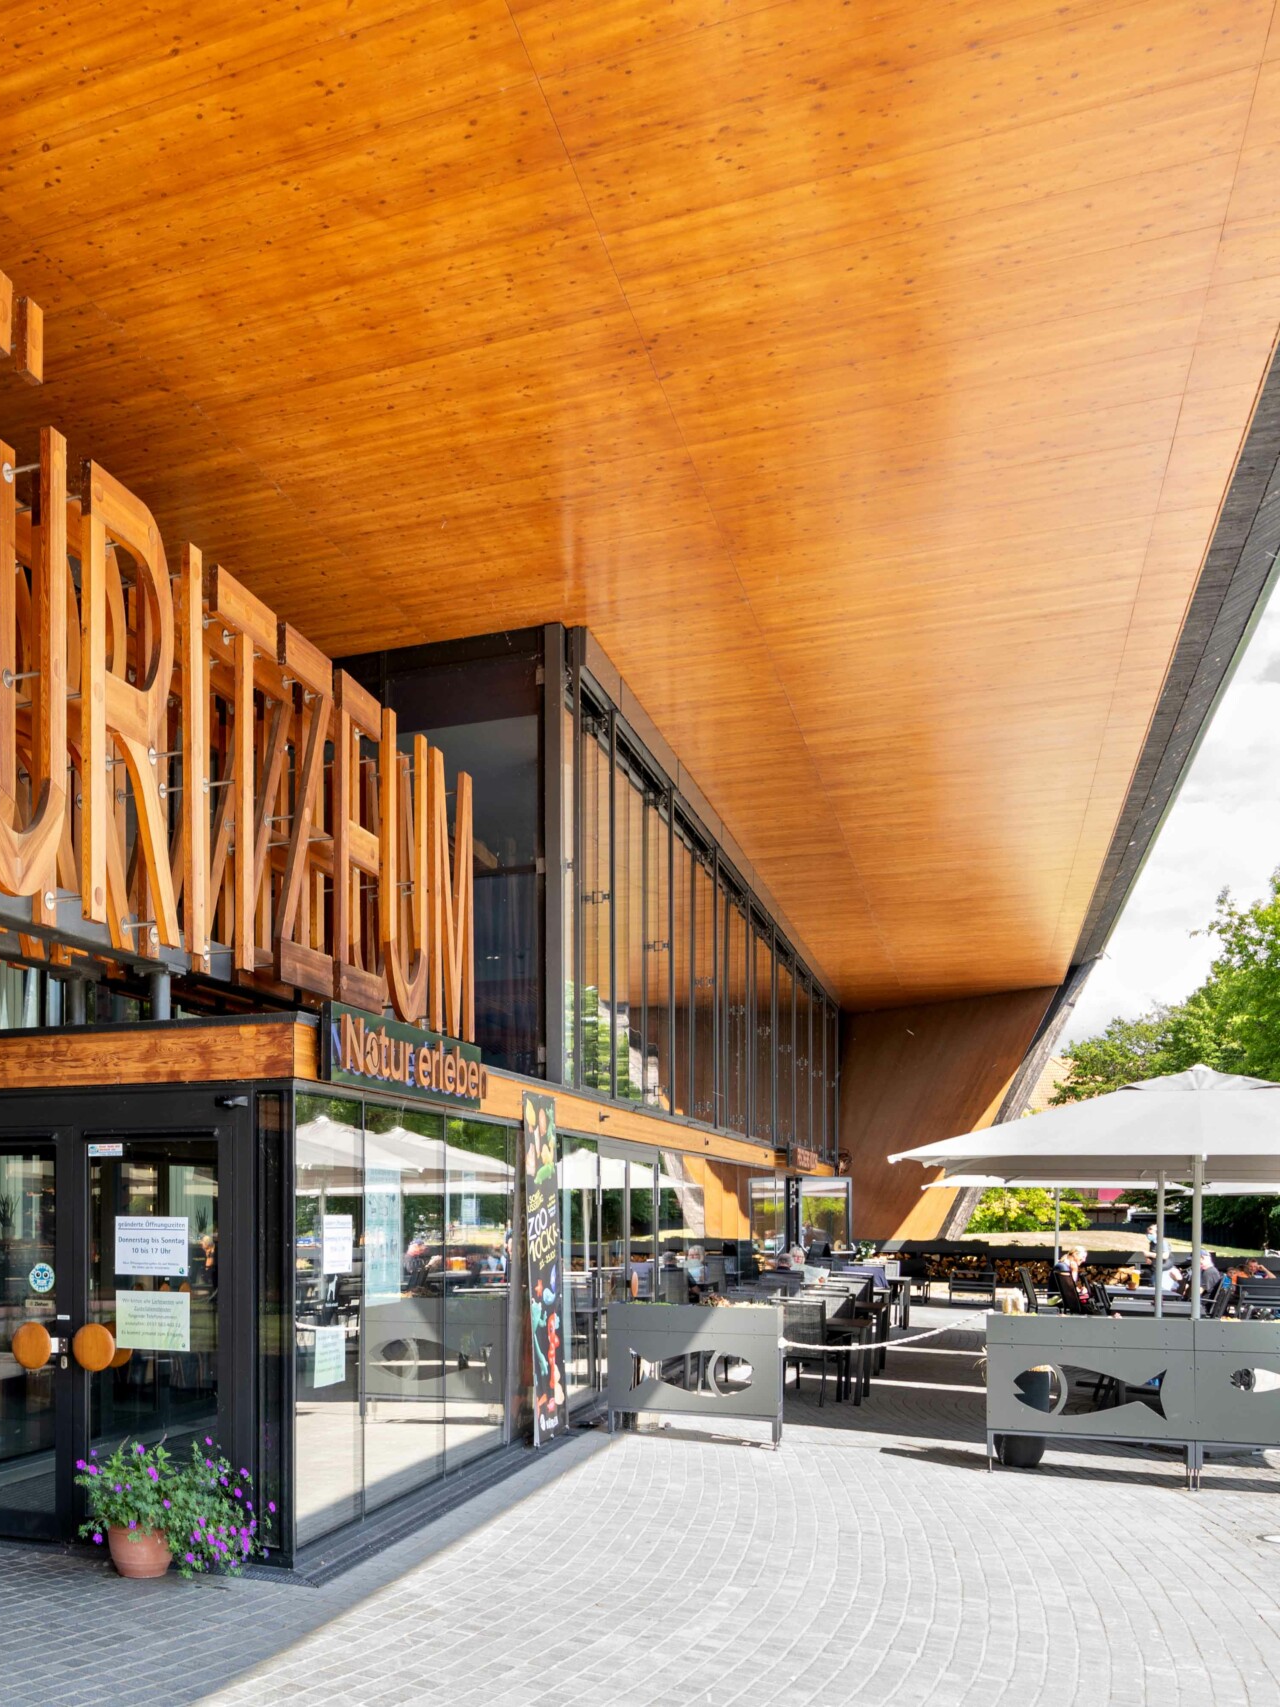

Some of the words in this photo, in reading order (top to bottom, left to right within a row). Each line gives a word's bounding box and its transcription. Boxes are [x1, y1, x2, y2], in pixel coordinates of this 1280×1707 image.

[415, 1040, 488, 1099] erleben
[145, 1220, 185, 1229] Öffnungszeiten
[528, 1207, 548, 1241] ZOO
[118, 1236, 149, 1245] Donnerstag
[161, 1237, 185, 1245] Sonntag
